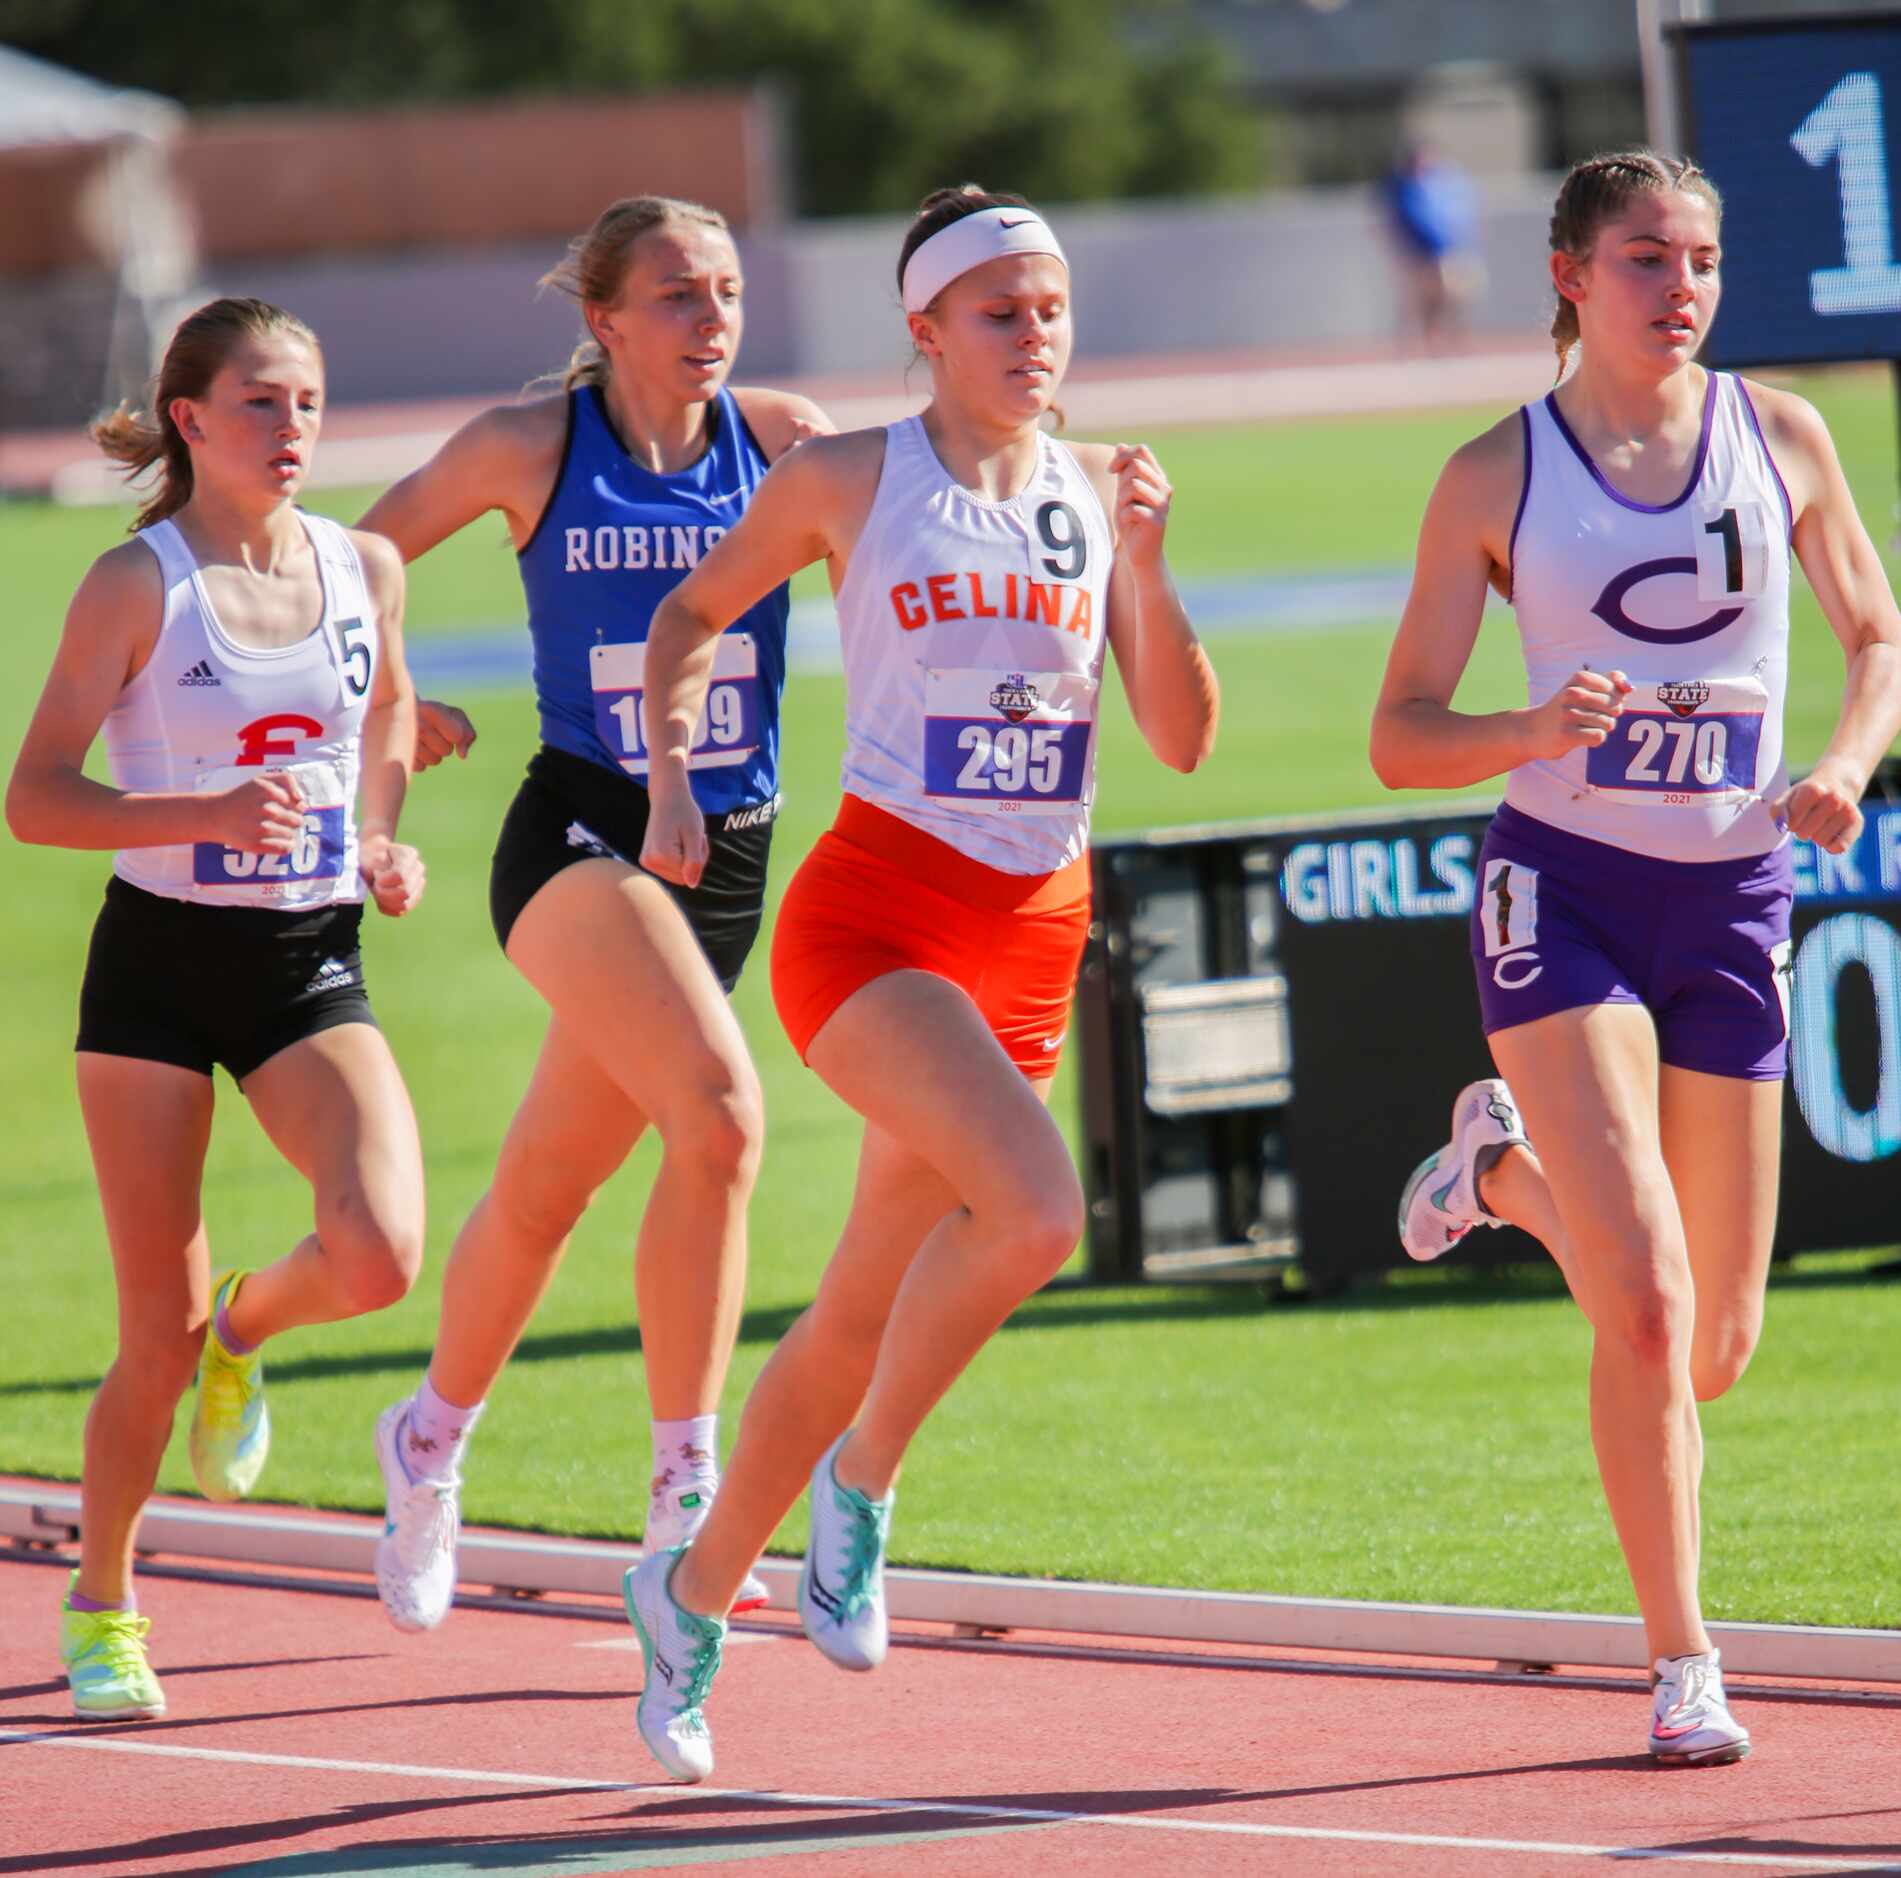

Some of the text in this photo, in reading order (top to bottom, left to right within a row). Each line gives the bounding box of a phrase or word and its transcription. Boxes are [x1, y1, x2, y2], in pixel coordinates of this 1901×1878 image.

[1790, 71, 1901, 316] 1
[1034, 500, 1087, 580] 9
[1704, 508, 1743, 592] 1
[890, 572, 1093, 640] CELINA
[1591, 556, 1745, 645] C
[177, 677, 221, 687] adidas
[334, 616, 370, 697] 5
[609, 685, 743, 753] 19
[991, 692, 1034, 706] STAT
[1658, 687, 1709, 700] STATE
[956, 725, 1063, 793] 295
[1625, 719, 1727, 785] 270
[723, 800, 773, 832] NIKE
[998, 802, 1022, 812] 2021
[1663, 794, 1690, 804] 2021
[1282, 834, 1476, 923] GIRLS
[1488, 865, 1512, 947] 1
[1493, 952, 1543, 989] C
